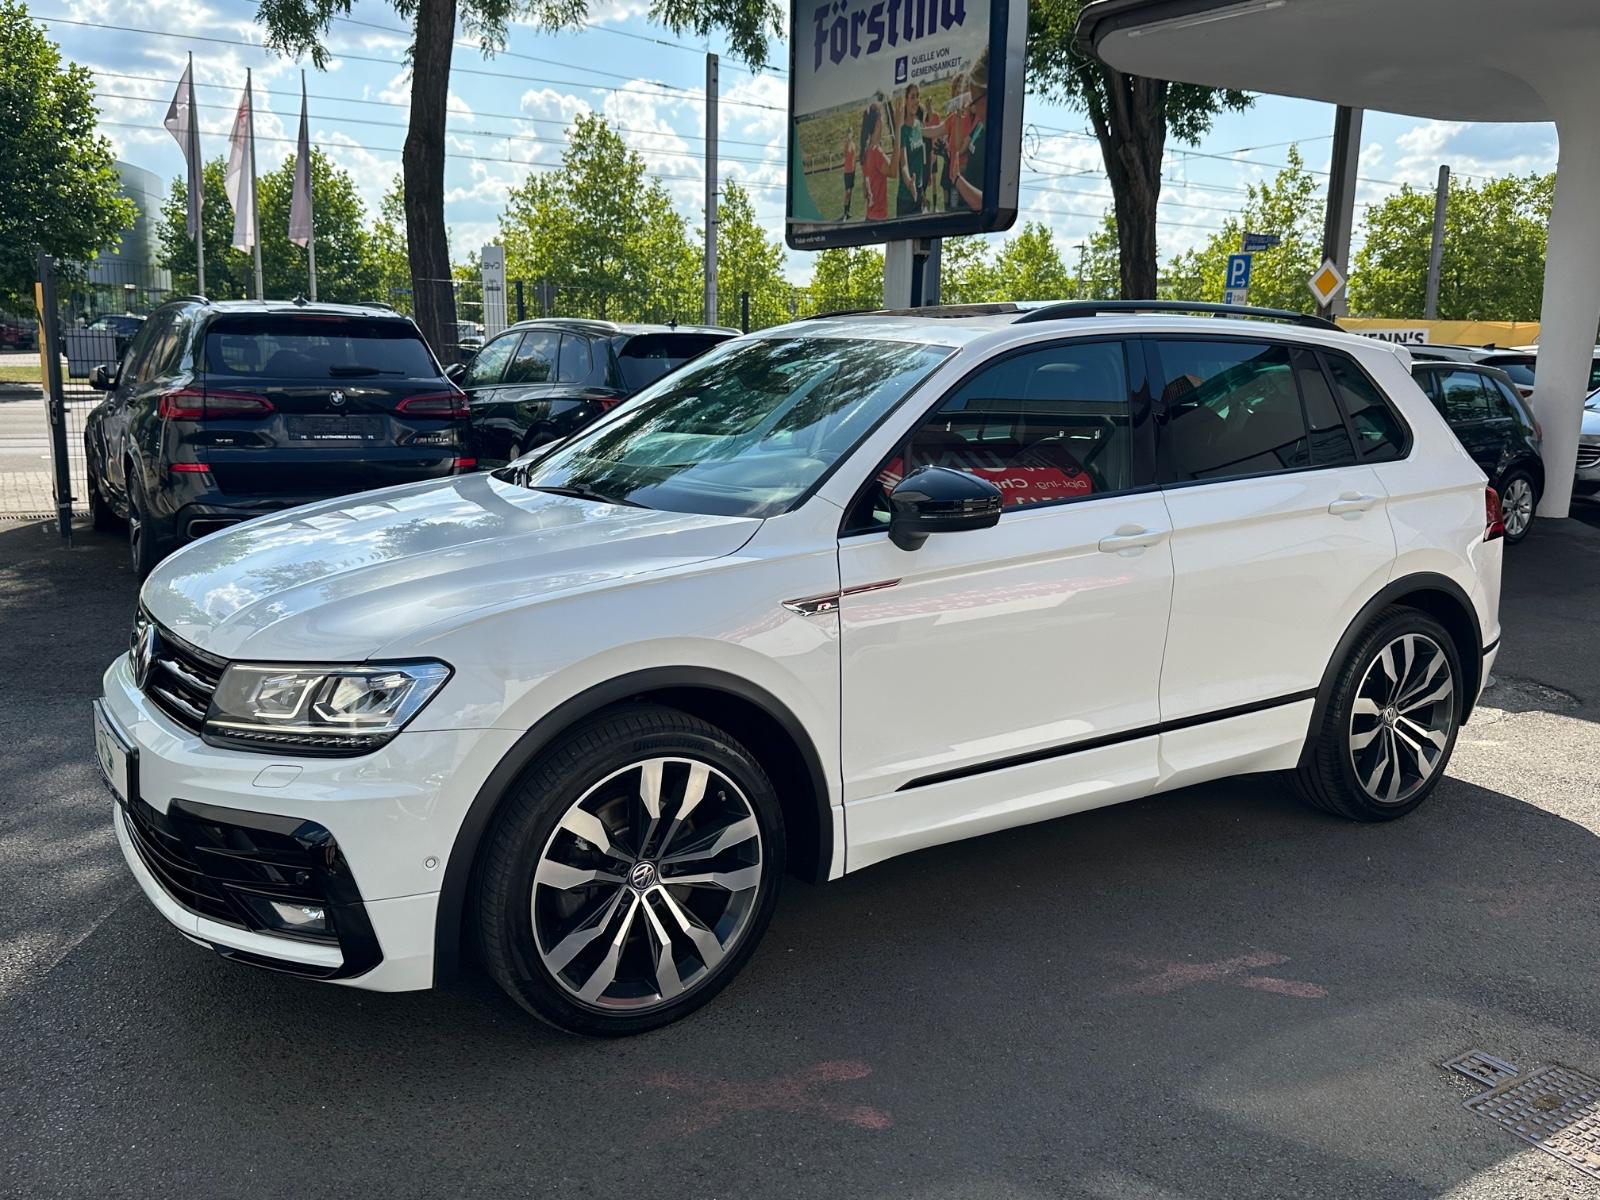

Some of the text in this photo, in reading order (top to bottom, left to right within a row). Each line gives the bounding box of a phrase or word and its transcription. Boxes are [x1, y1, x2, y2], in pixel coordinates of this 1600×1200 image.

[911, 47, 950, 65] QUELLE VON
[911, 56, 962, 78] GEMEINSAMKEIT
[1231, 258, 1245, 286] P
